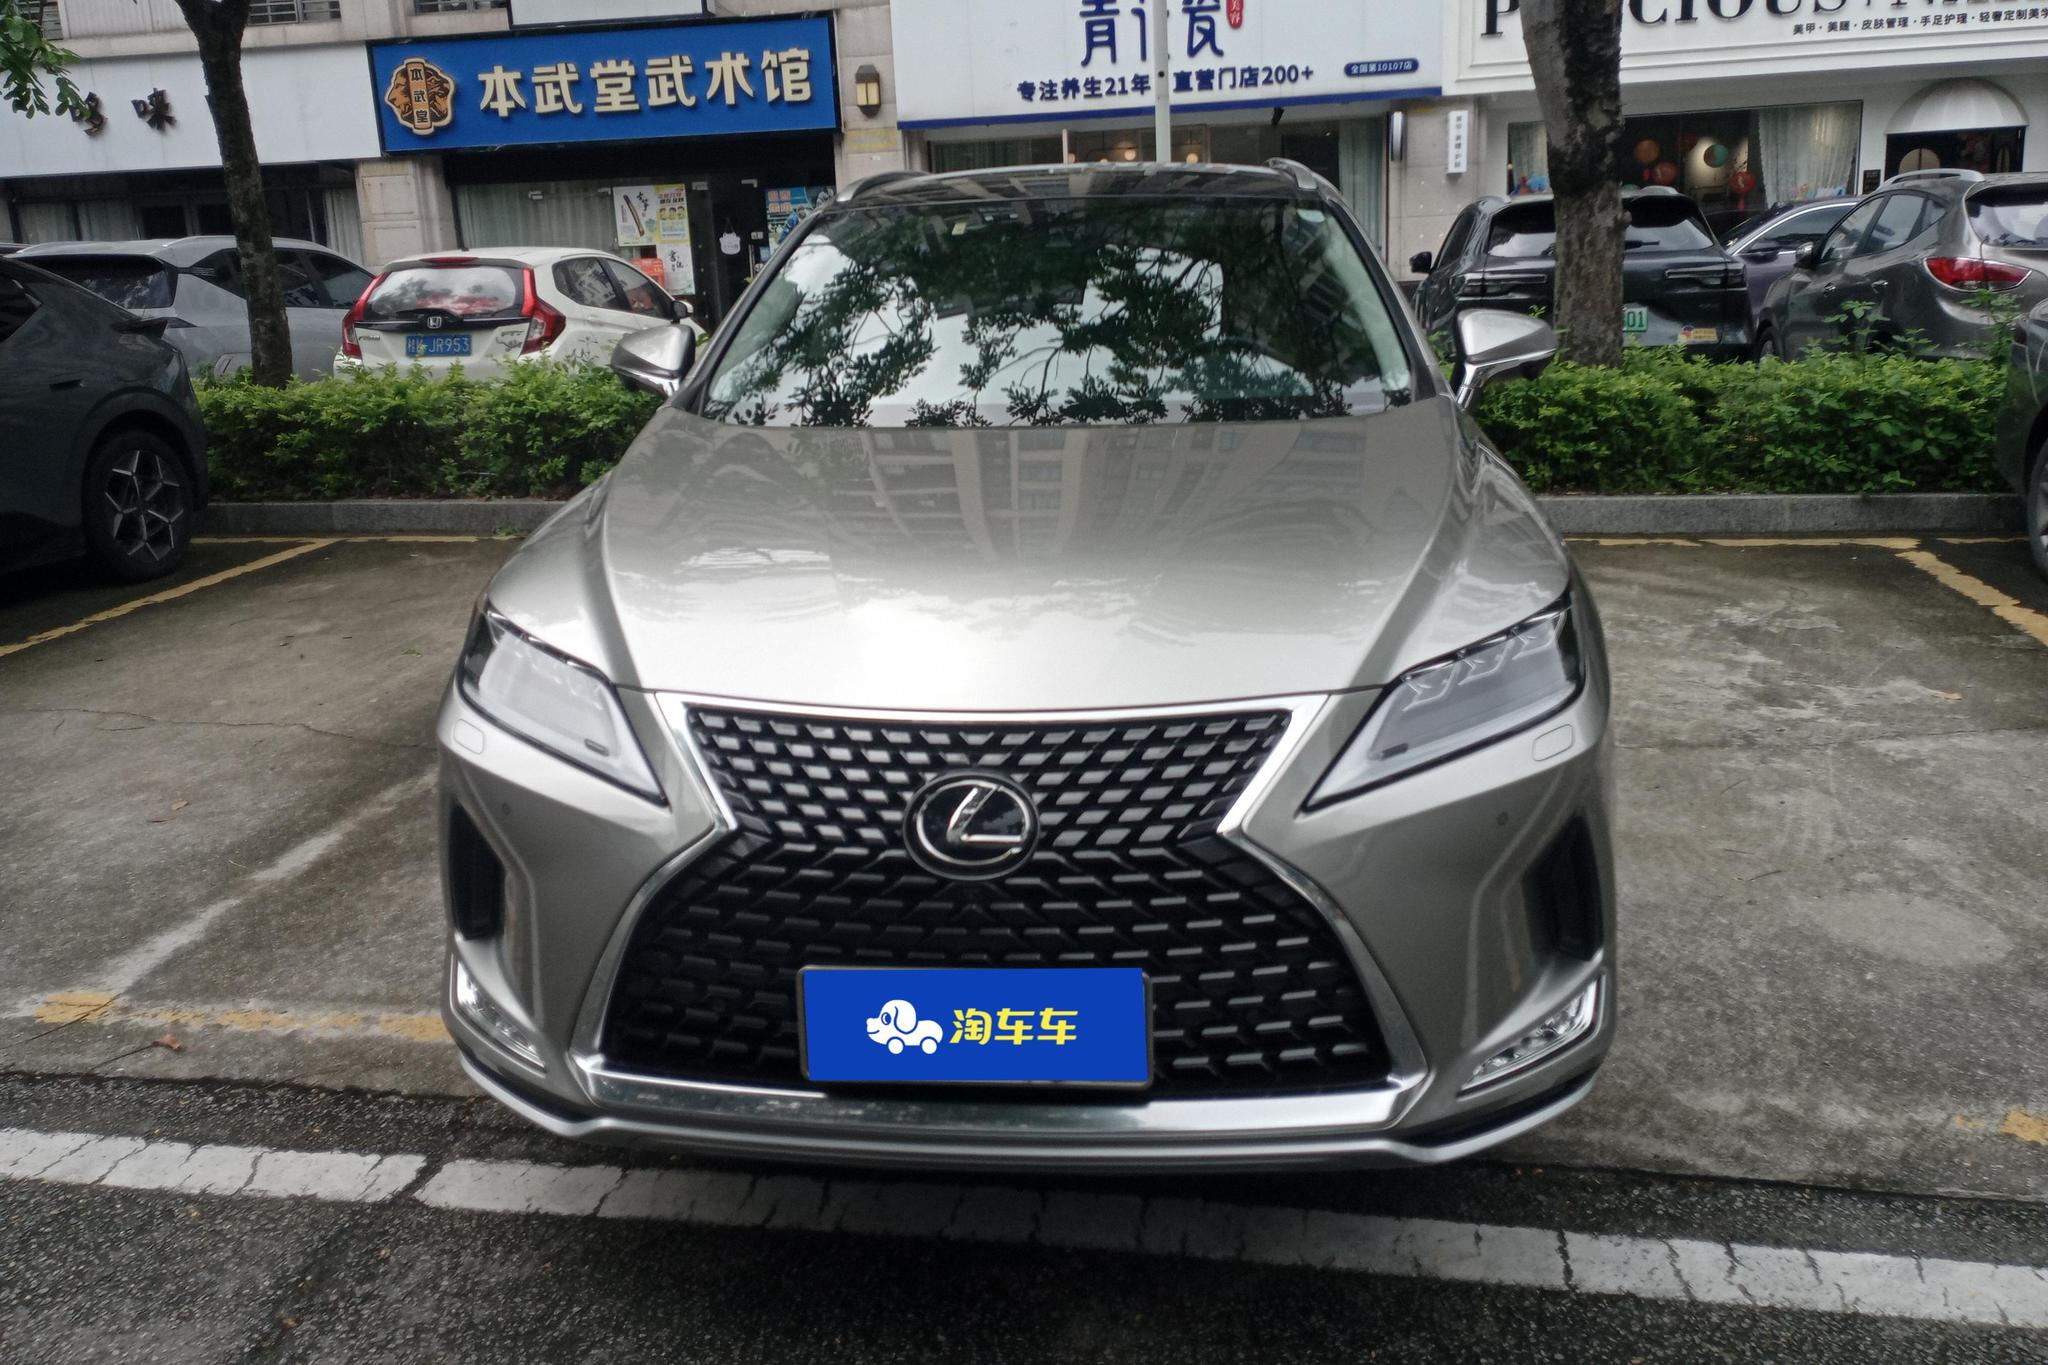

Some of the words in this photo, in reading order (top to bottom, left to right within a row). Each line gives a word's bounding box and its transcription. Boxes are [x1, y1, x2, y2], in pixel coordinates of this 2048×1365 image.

[477, 47, 813, 118] 本武堂武术馆
[1016, 73, 1152, 102] 专注养生21年
[1172, 64, 1315, 94] 直营门店200+
[1626, 311, 1645, 328] 01
